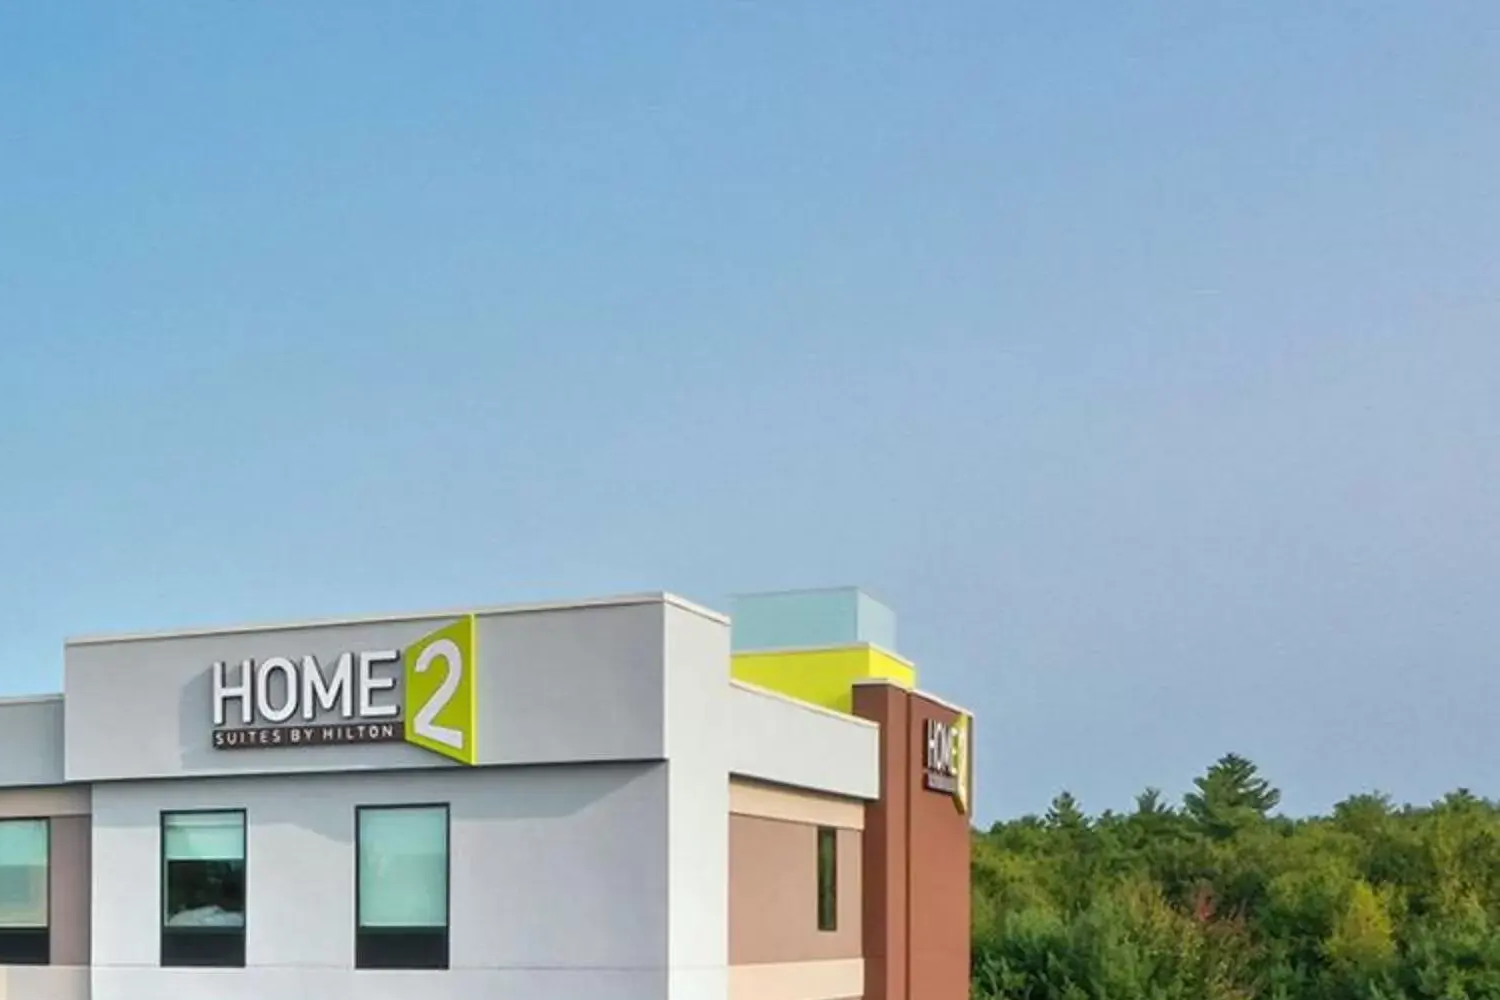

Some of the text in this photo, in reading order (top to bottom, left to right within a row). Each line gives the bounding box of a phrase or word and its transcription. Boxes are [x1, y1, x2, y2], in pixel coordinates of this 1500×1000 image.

[212, 638, 463, 749] HOME 2
[215, 725, 393, 745] SUITES BY HILTON
